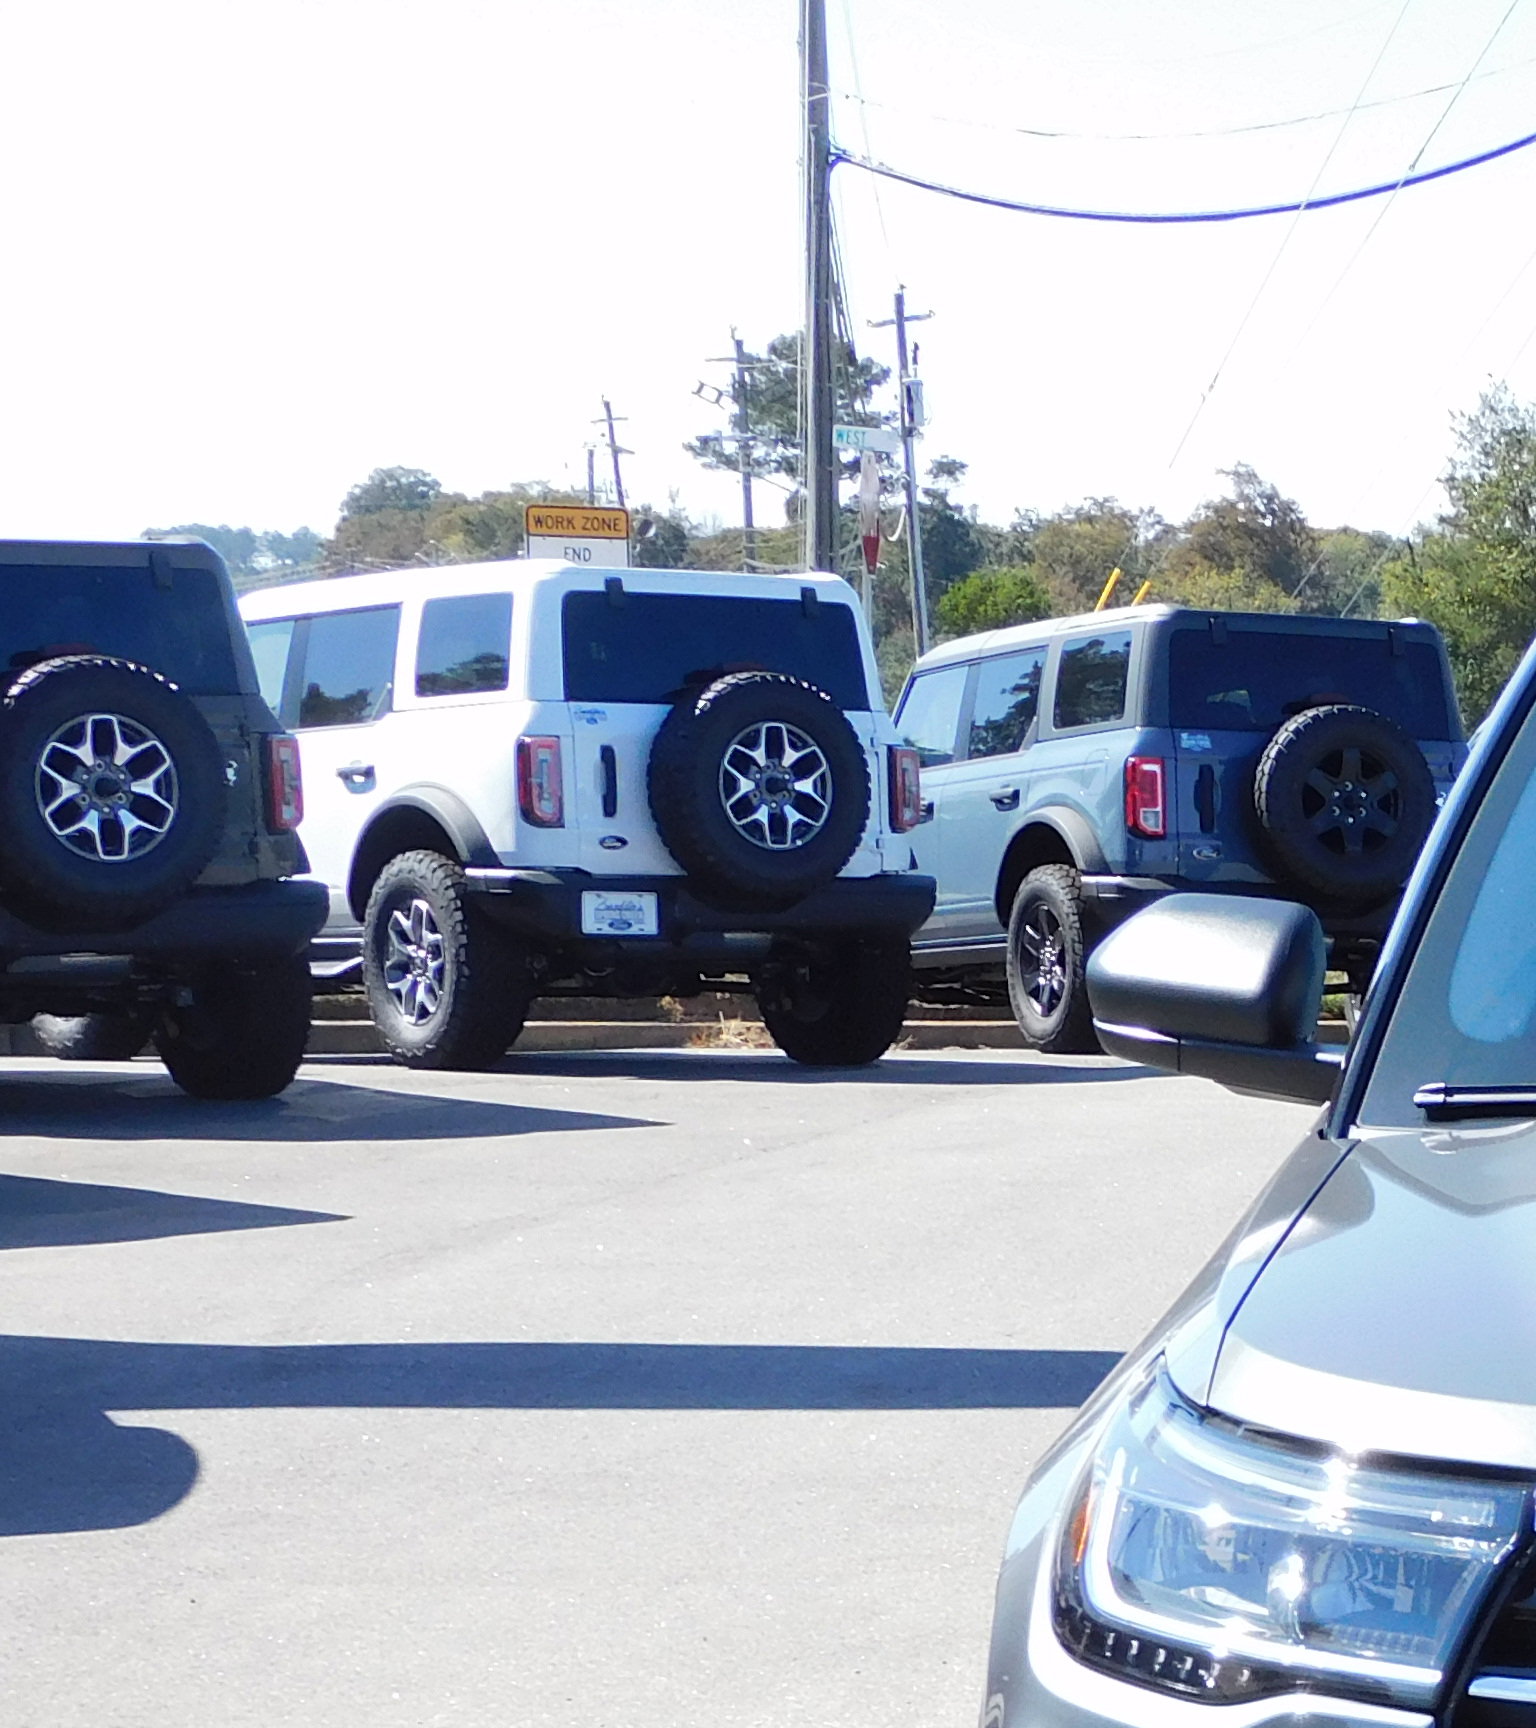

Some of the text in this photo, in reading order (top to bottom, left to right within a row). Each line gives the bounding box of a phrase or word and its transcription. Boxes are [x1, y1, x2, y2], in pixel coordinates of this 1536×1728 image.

[533, 515, 622, 532] WORK ZONE
[563, 546, 592, 562] END
